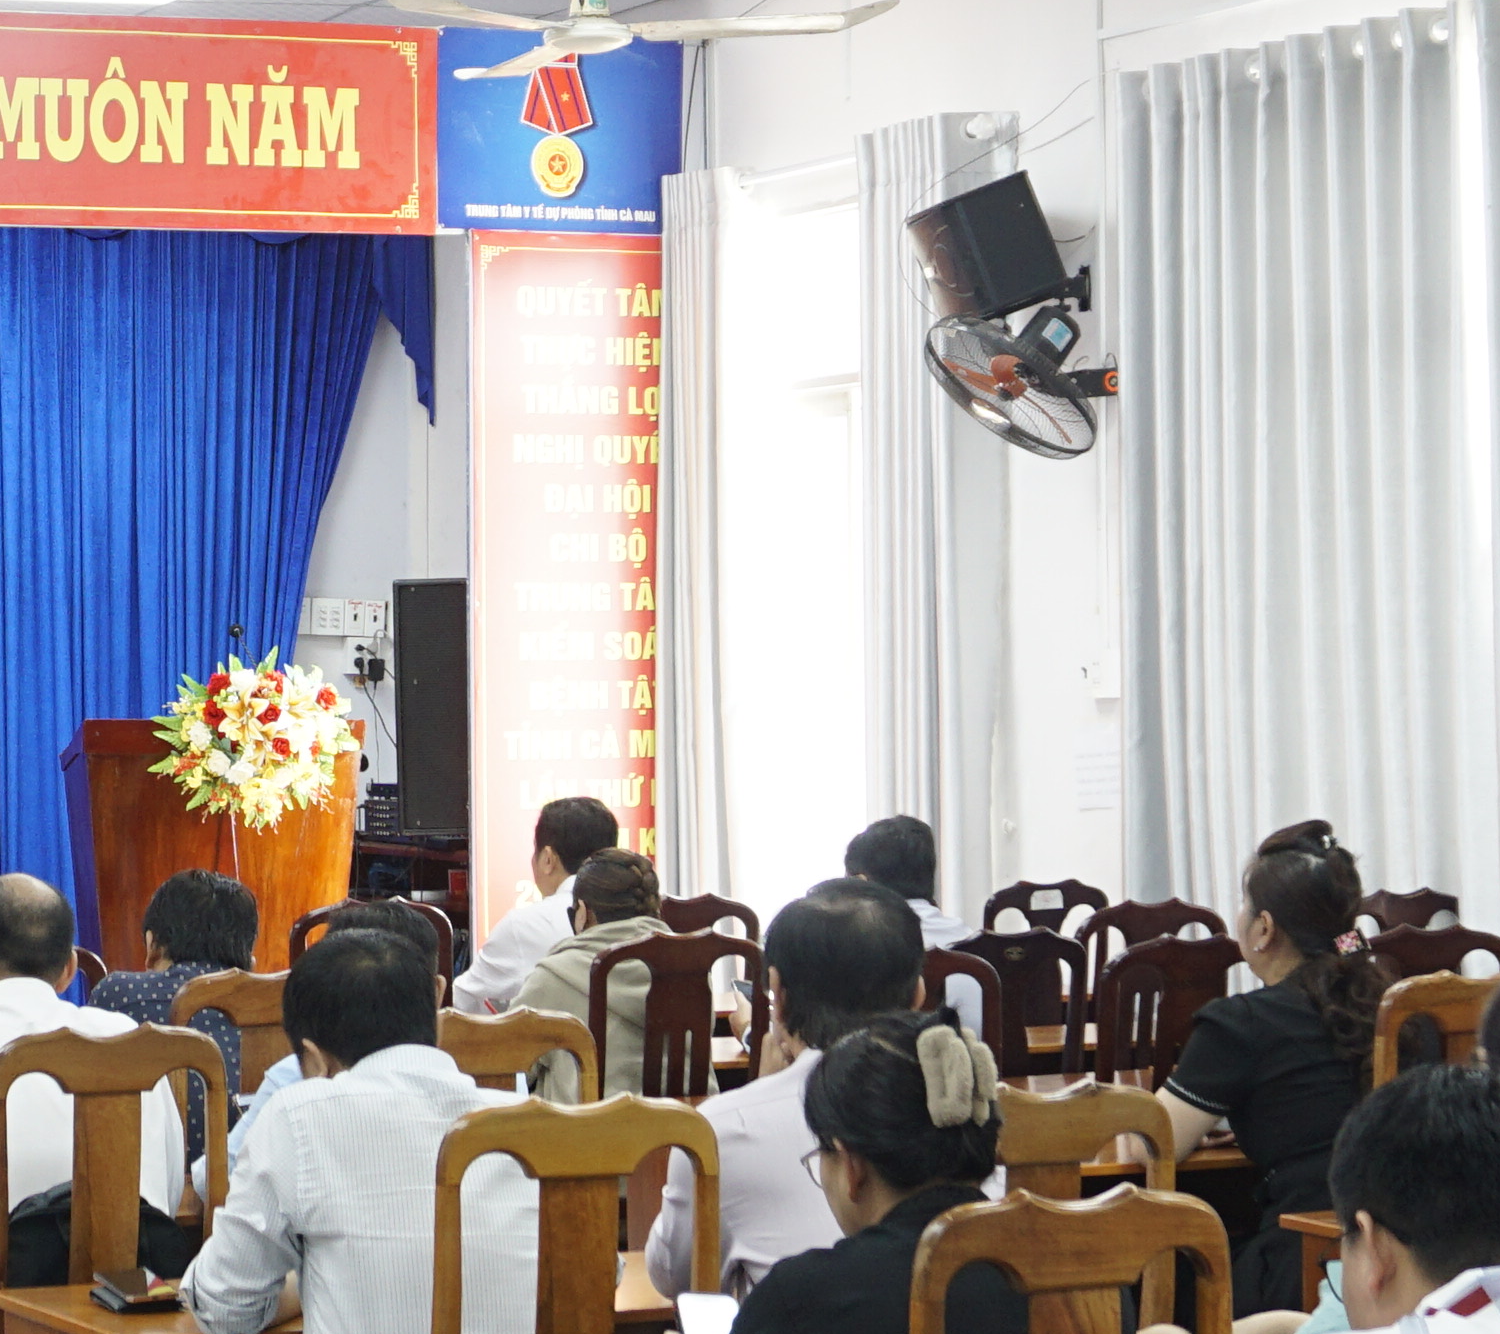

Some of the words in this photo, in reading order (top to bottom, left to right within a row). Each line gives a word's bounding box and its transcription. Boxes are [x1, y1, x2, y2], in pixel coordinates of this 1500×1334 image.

[204, 63, 362, 171] NĂM
[465, 204, 499, 218] TRUNG
[500, 203, 522, 218] TÂM
[522, 206, 531, 218] Y
[532, 203, 545, 219] TẾ
[561, 206, 595, 221] PHÒNG
[619, 207, 633, 222] CÀ
[634, 210, 656, 223] MAU
[516, 278, 607, 318] QUYẾT
[512, 434, 584, 470] NGHỊ
[543, 483, 594, 519] ĐẠI
[603, 479, 652, 519] HỘI
[608, 528, 647, 569] BỘ
[514, 582, 611, 613] TRUNG
[616, 674, 656, 715] TẬ
[579, 724, 621, 760] CÀ
